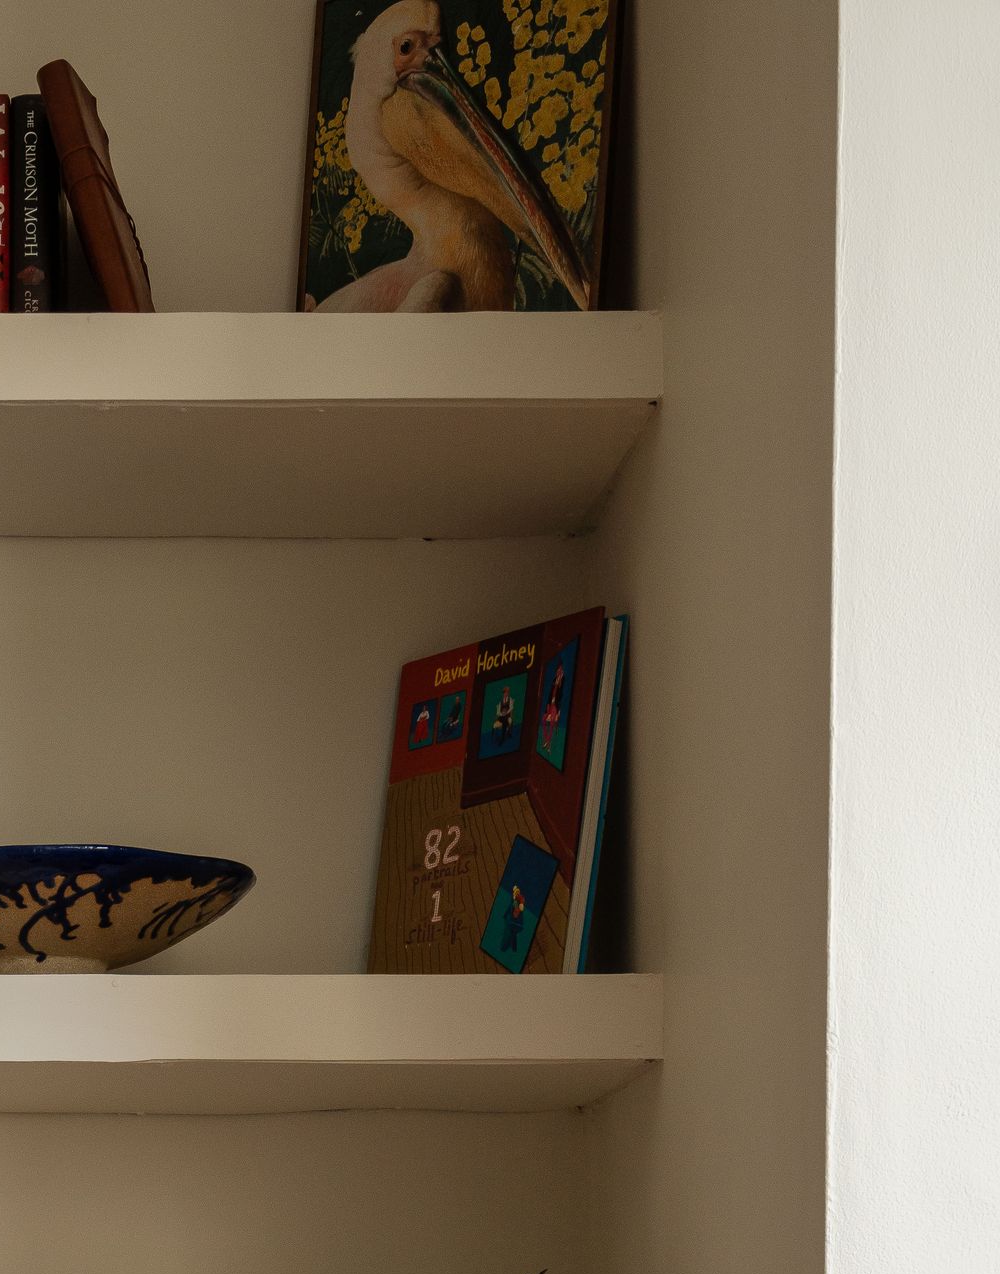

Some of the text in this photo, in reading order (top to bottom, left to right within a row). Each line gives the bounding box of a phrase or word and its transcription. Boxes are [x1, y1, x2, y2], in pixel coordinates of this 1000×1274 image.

[23, 110, 39, 257] THE CRIMSON MOTH
[434, 643, 536, 687] David Hockney
[424, 825, 461, 870] 82
[431, 890, 442, 922] 1
